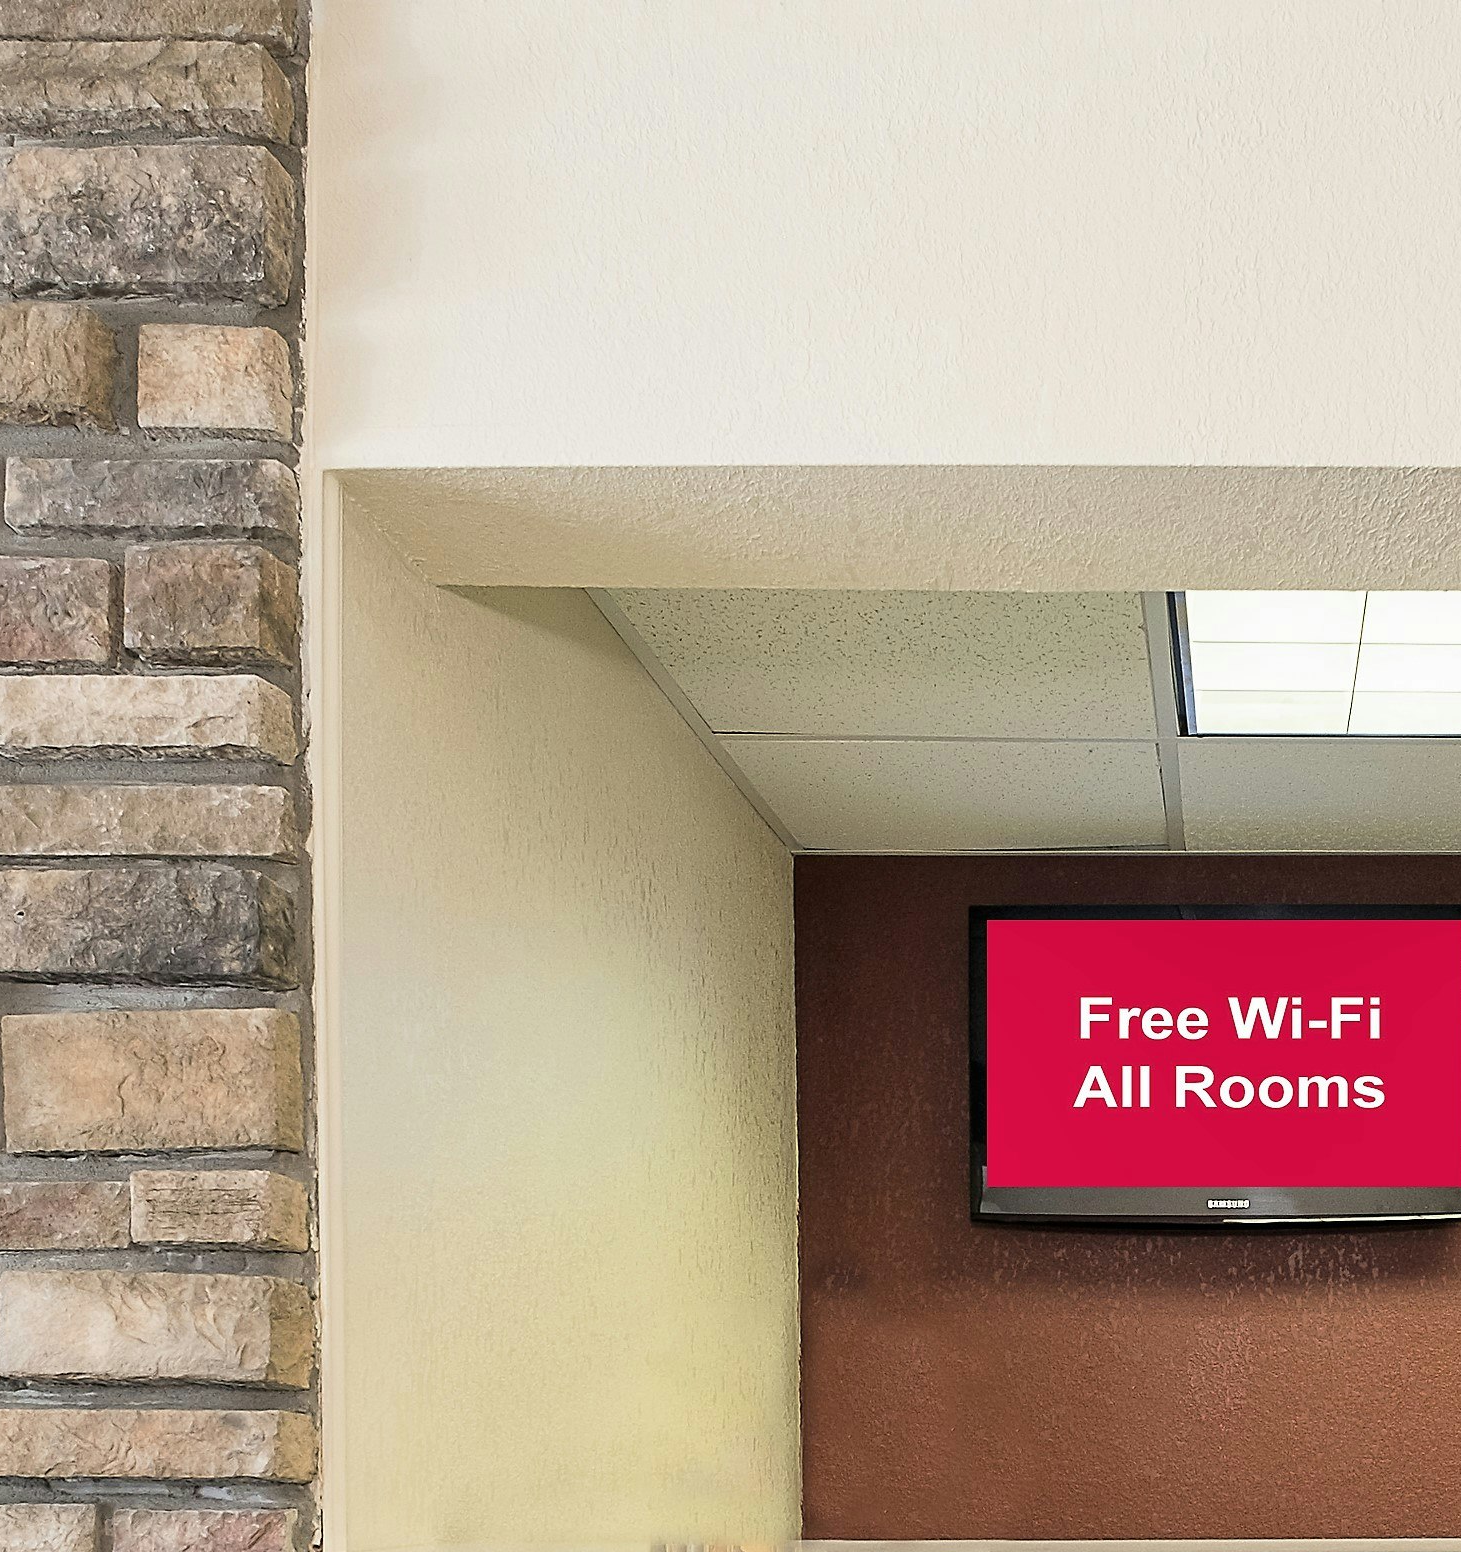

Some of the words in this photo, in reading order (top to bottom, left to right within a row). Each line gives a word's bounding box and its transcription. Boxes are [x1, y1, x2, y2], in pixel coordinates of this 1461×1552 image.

[1080, 996, 1209, 1040] Free
[1227, 996, 1382, 1040] Wi-Fi
[1072, 1065, 1151, 1109] All
[1175, 1065, 1386, 1109] Rooms
